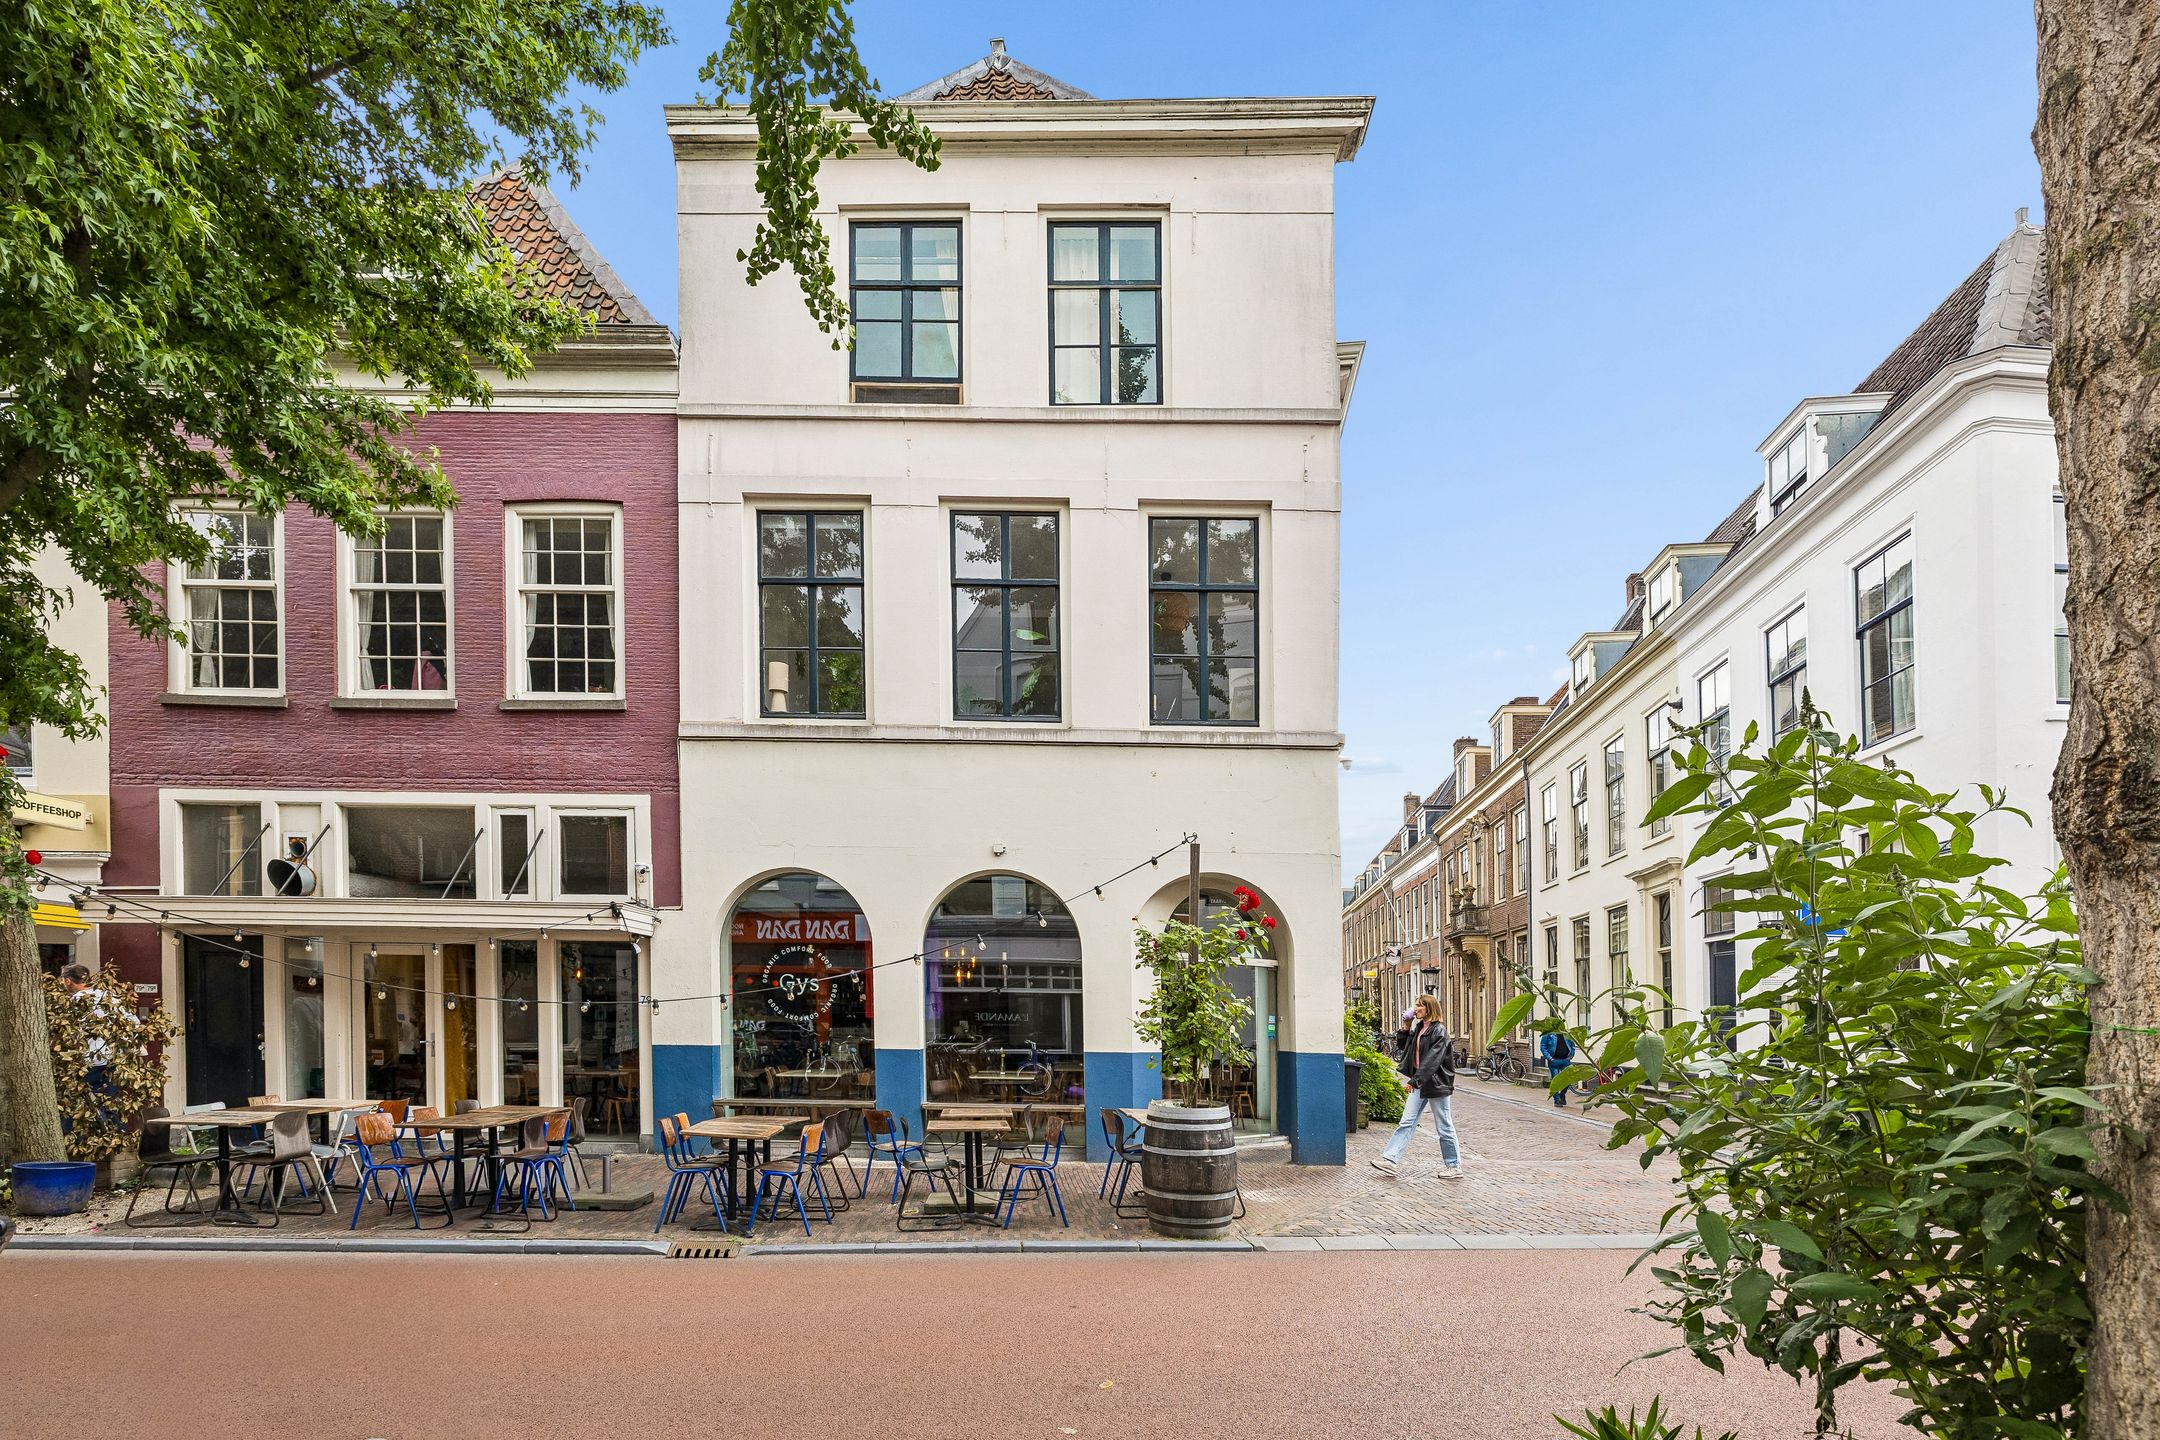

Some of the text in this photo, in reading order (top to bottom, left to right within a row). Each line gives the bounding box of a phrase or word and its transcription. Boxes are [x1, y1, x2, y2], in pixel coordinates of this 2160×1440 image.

[762, 945, 833, 984] ORGANIC COMFORT FOOD
[767, 983, 838, 1021] ORGANIC COMFORT FOOD
[780, 973, 820, 996] Gys
